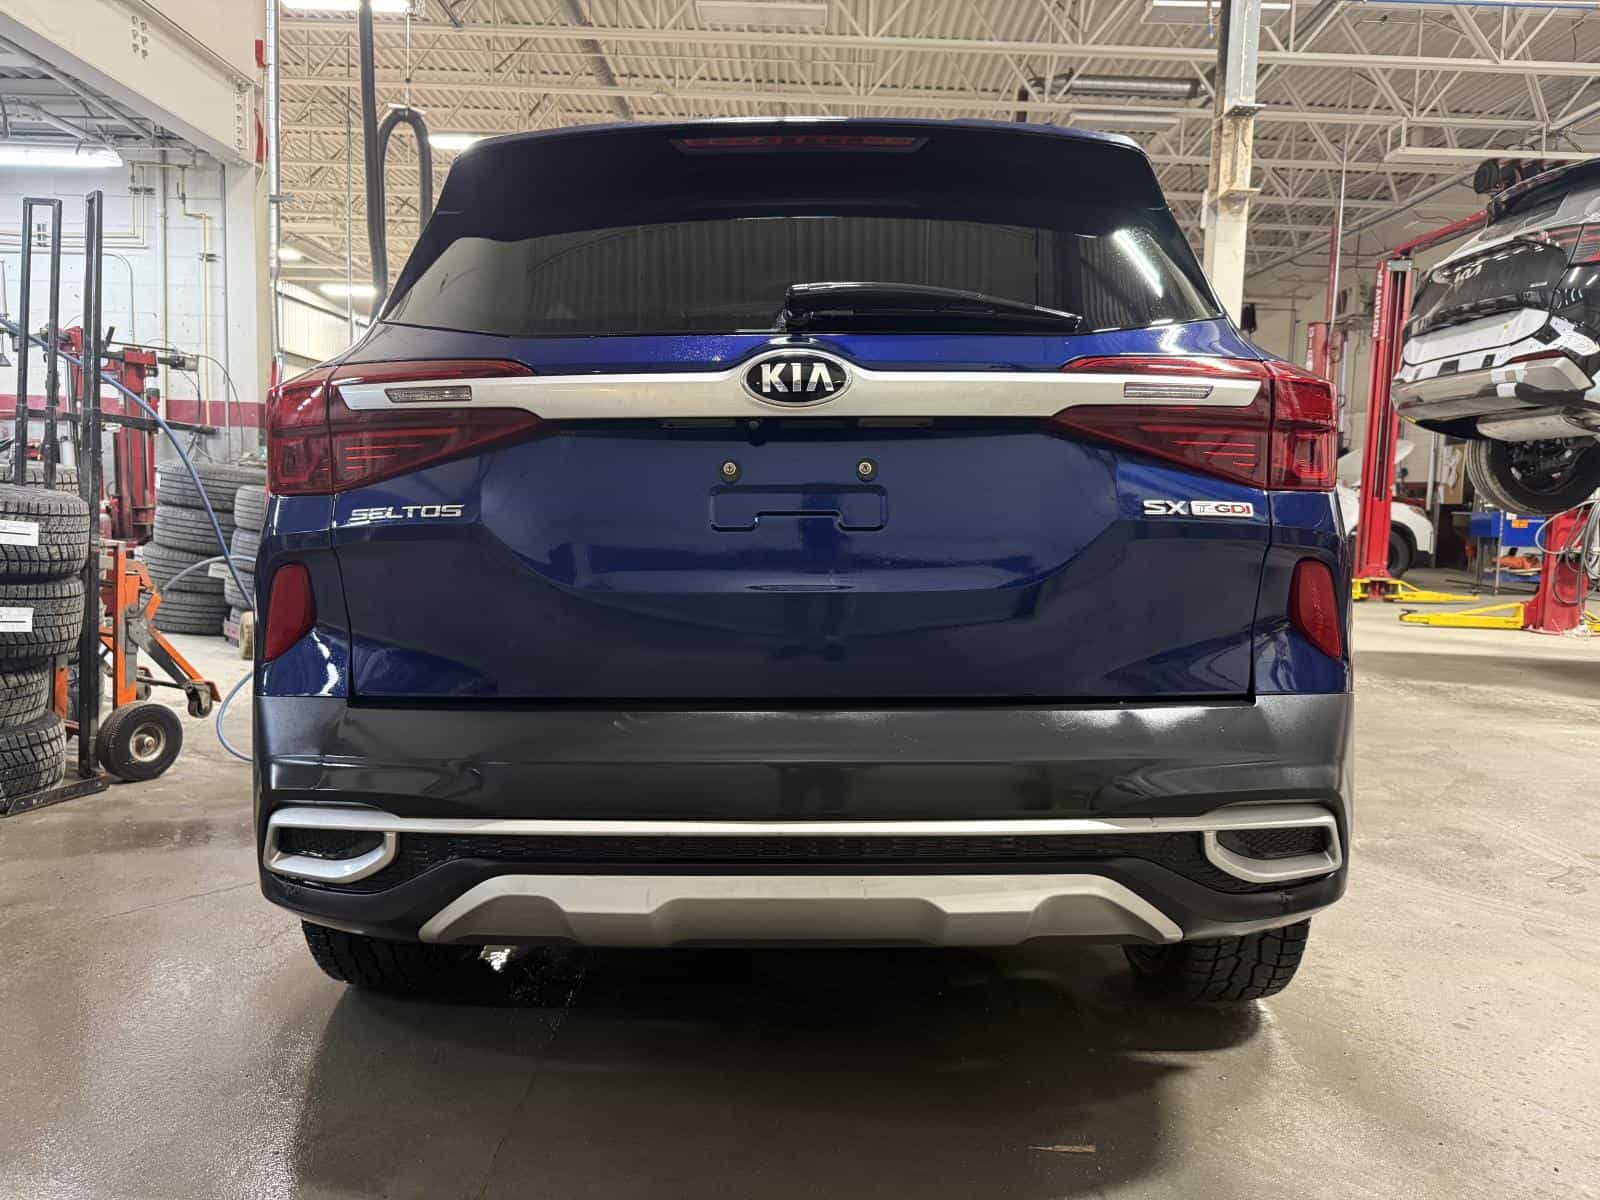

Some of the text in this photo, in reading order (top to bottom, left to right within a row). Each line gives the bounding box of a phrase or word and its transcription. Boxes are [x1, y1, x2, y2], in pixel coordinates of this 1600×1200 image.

[1372, 288, 1382, 338] ROTARY
[761, 362, 835, 393] KIA
[348, 504, 465, 521] SELTOS
[1143, 500, 1189, 515] SX
